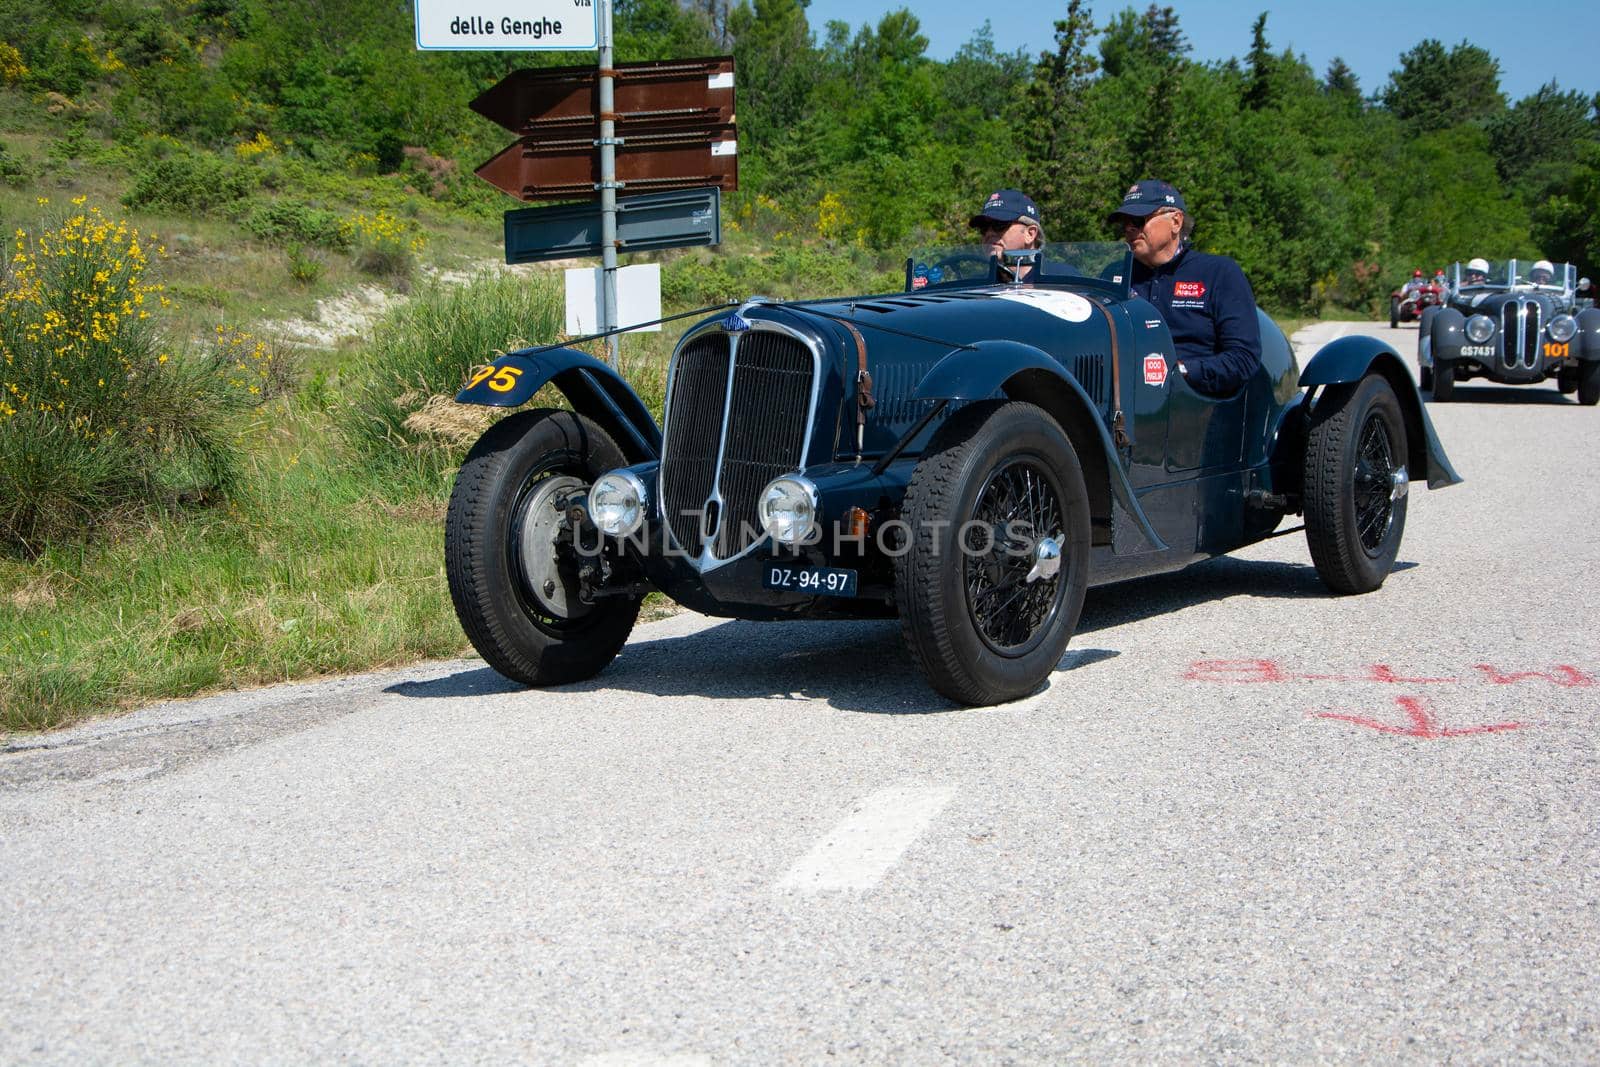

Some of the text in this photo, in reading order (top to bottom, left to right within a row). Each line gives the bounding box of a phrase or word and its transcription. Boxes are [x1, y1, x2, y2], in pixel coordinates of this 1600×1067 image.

[450, 16, 562, 39] delle Genghe
[1543, 342, 1569, 358] 101
[1147, 360, 1162, 370] 1000
[465, 365, 524, 392] 95
[770, 568, 848, 591] DZ-94-97
